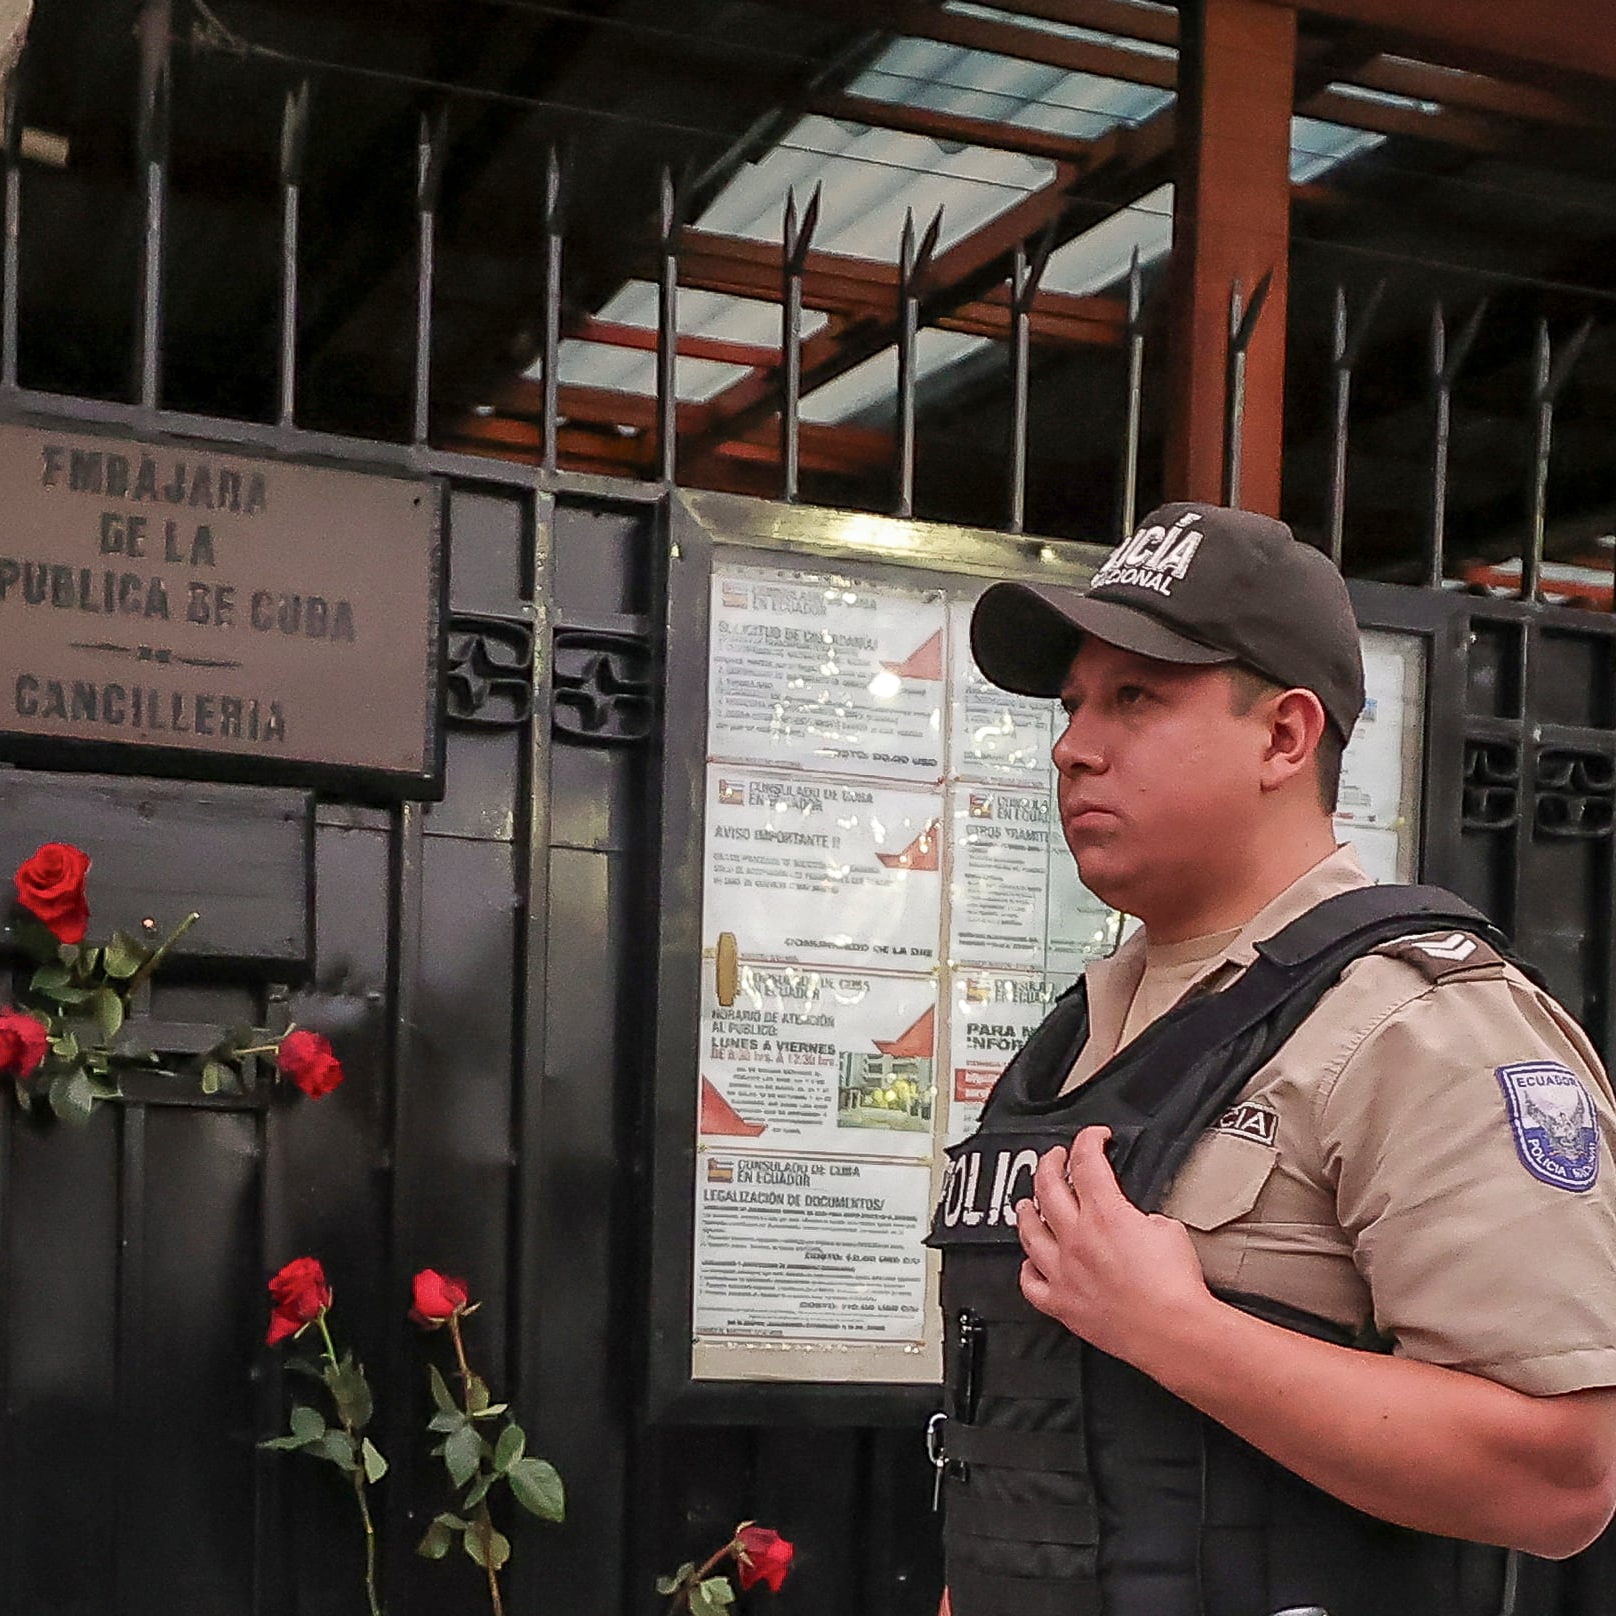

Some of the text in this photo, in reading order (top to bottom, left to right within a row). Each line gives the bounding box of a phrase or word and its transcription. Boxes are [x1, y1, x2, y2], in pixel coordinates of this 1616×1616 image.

[100, 511, 215, 567] DE LA
[187, 580, 237, 627] DE
[250, 589, 356, 643] CUBA
[14, 673, 286, 743] CANCILLERIA
[966, 1023, 1016, 1038] PARA
[711, 1036, 836, 1055] LUNES A VIERNES
[1515, 1074, 1579, 1088] ECUADOR
[1527, 1138, 1568, 1177] POLICIA
[737, 1159, 809, 1175] CONSULADO
[737, 1172, 811, 1187] EN ECUADOR
[787, 1194, 801, 1208] DE
